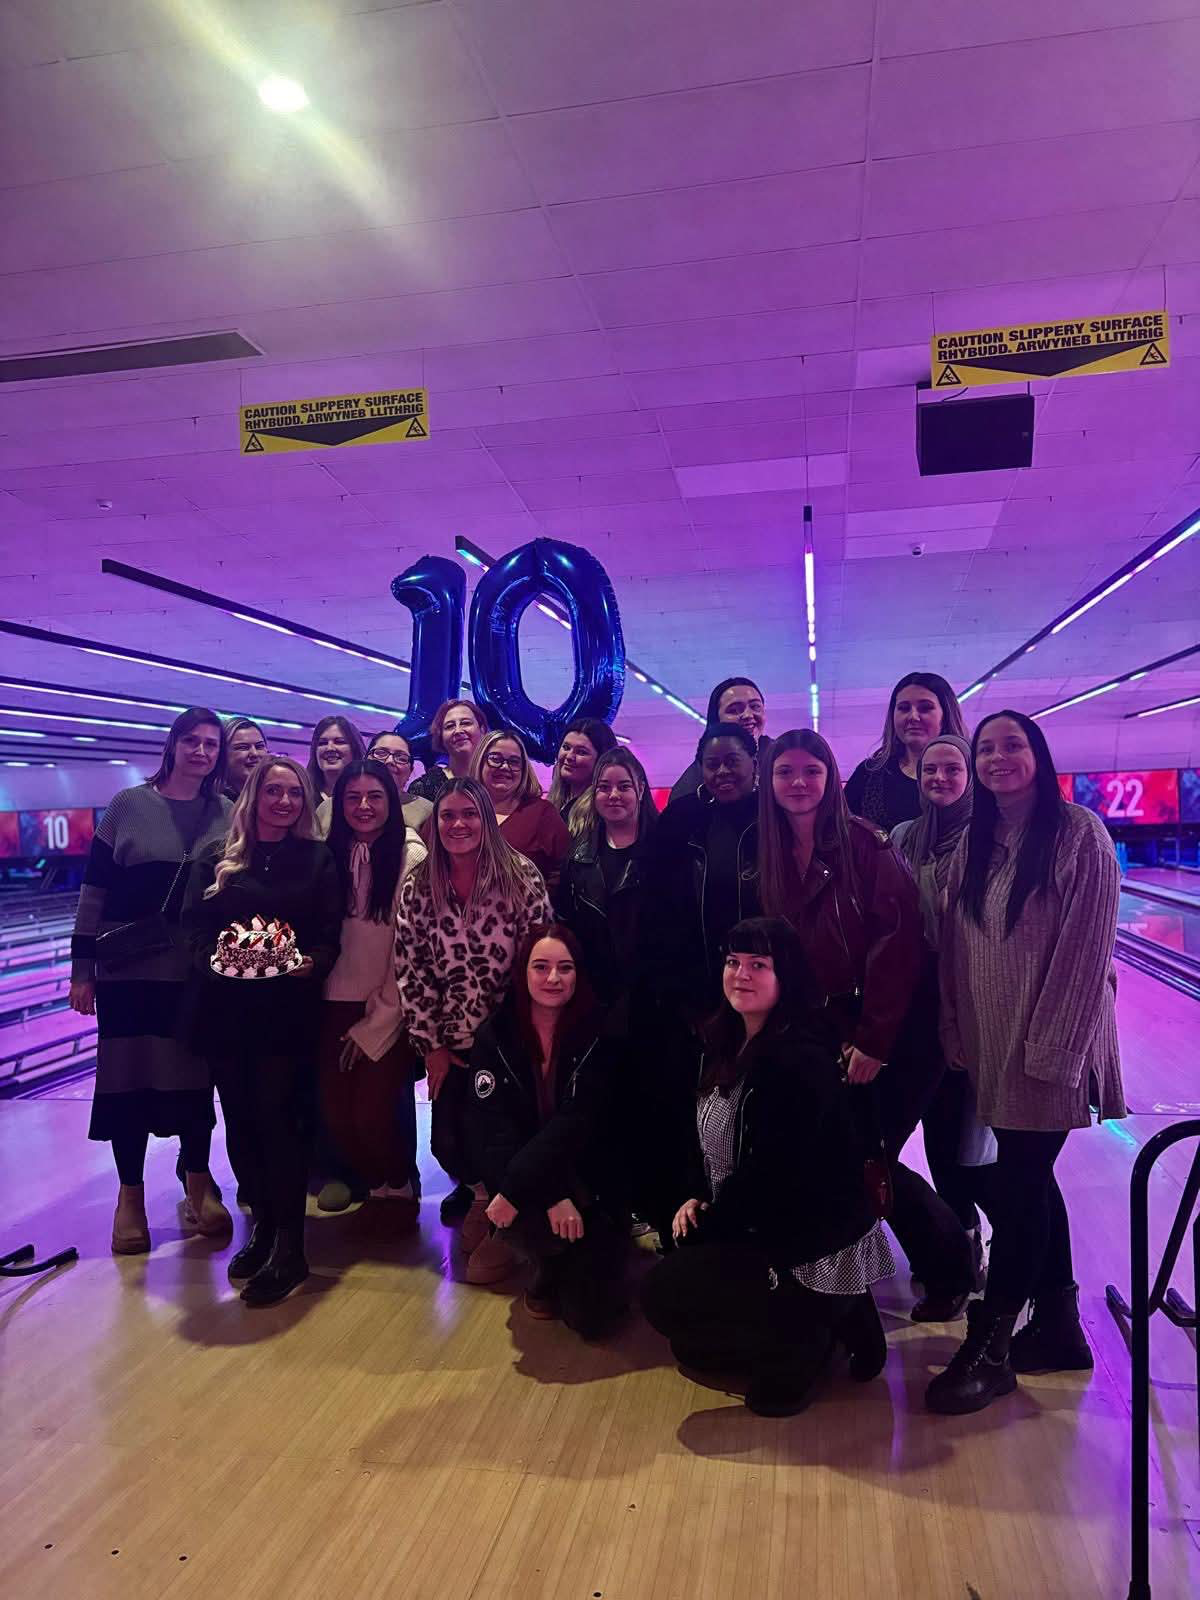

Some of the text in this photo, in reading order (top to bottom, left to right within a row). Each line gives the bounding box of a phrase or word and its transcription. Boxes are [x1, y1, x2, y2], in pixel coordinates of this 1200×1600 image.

[937, 314, 1163, 349] CAUTION SLIPPERY SURFACE
[938, 327, 1164, 361] RHYBUDD. ARWYNEB LLITHRIG
[244, 392, 423, 419] CAUTION SLIPPERY SURFACE
[244, 403, 424, 430] RHYBUDD. ARWYNEB LLITHRIG
[389, 536, 626, 766] 10
[1106, 778, 1144, 818] 22
[43, 815, 69, 850] 10
